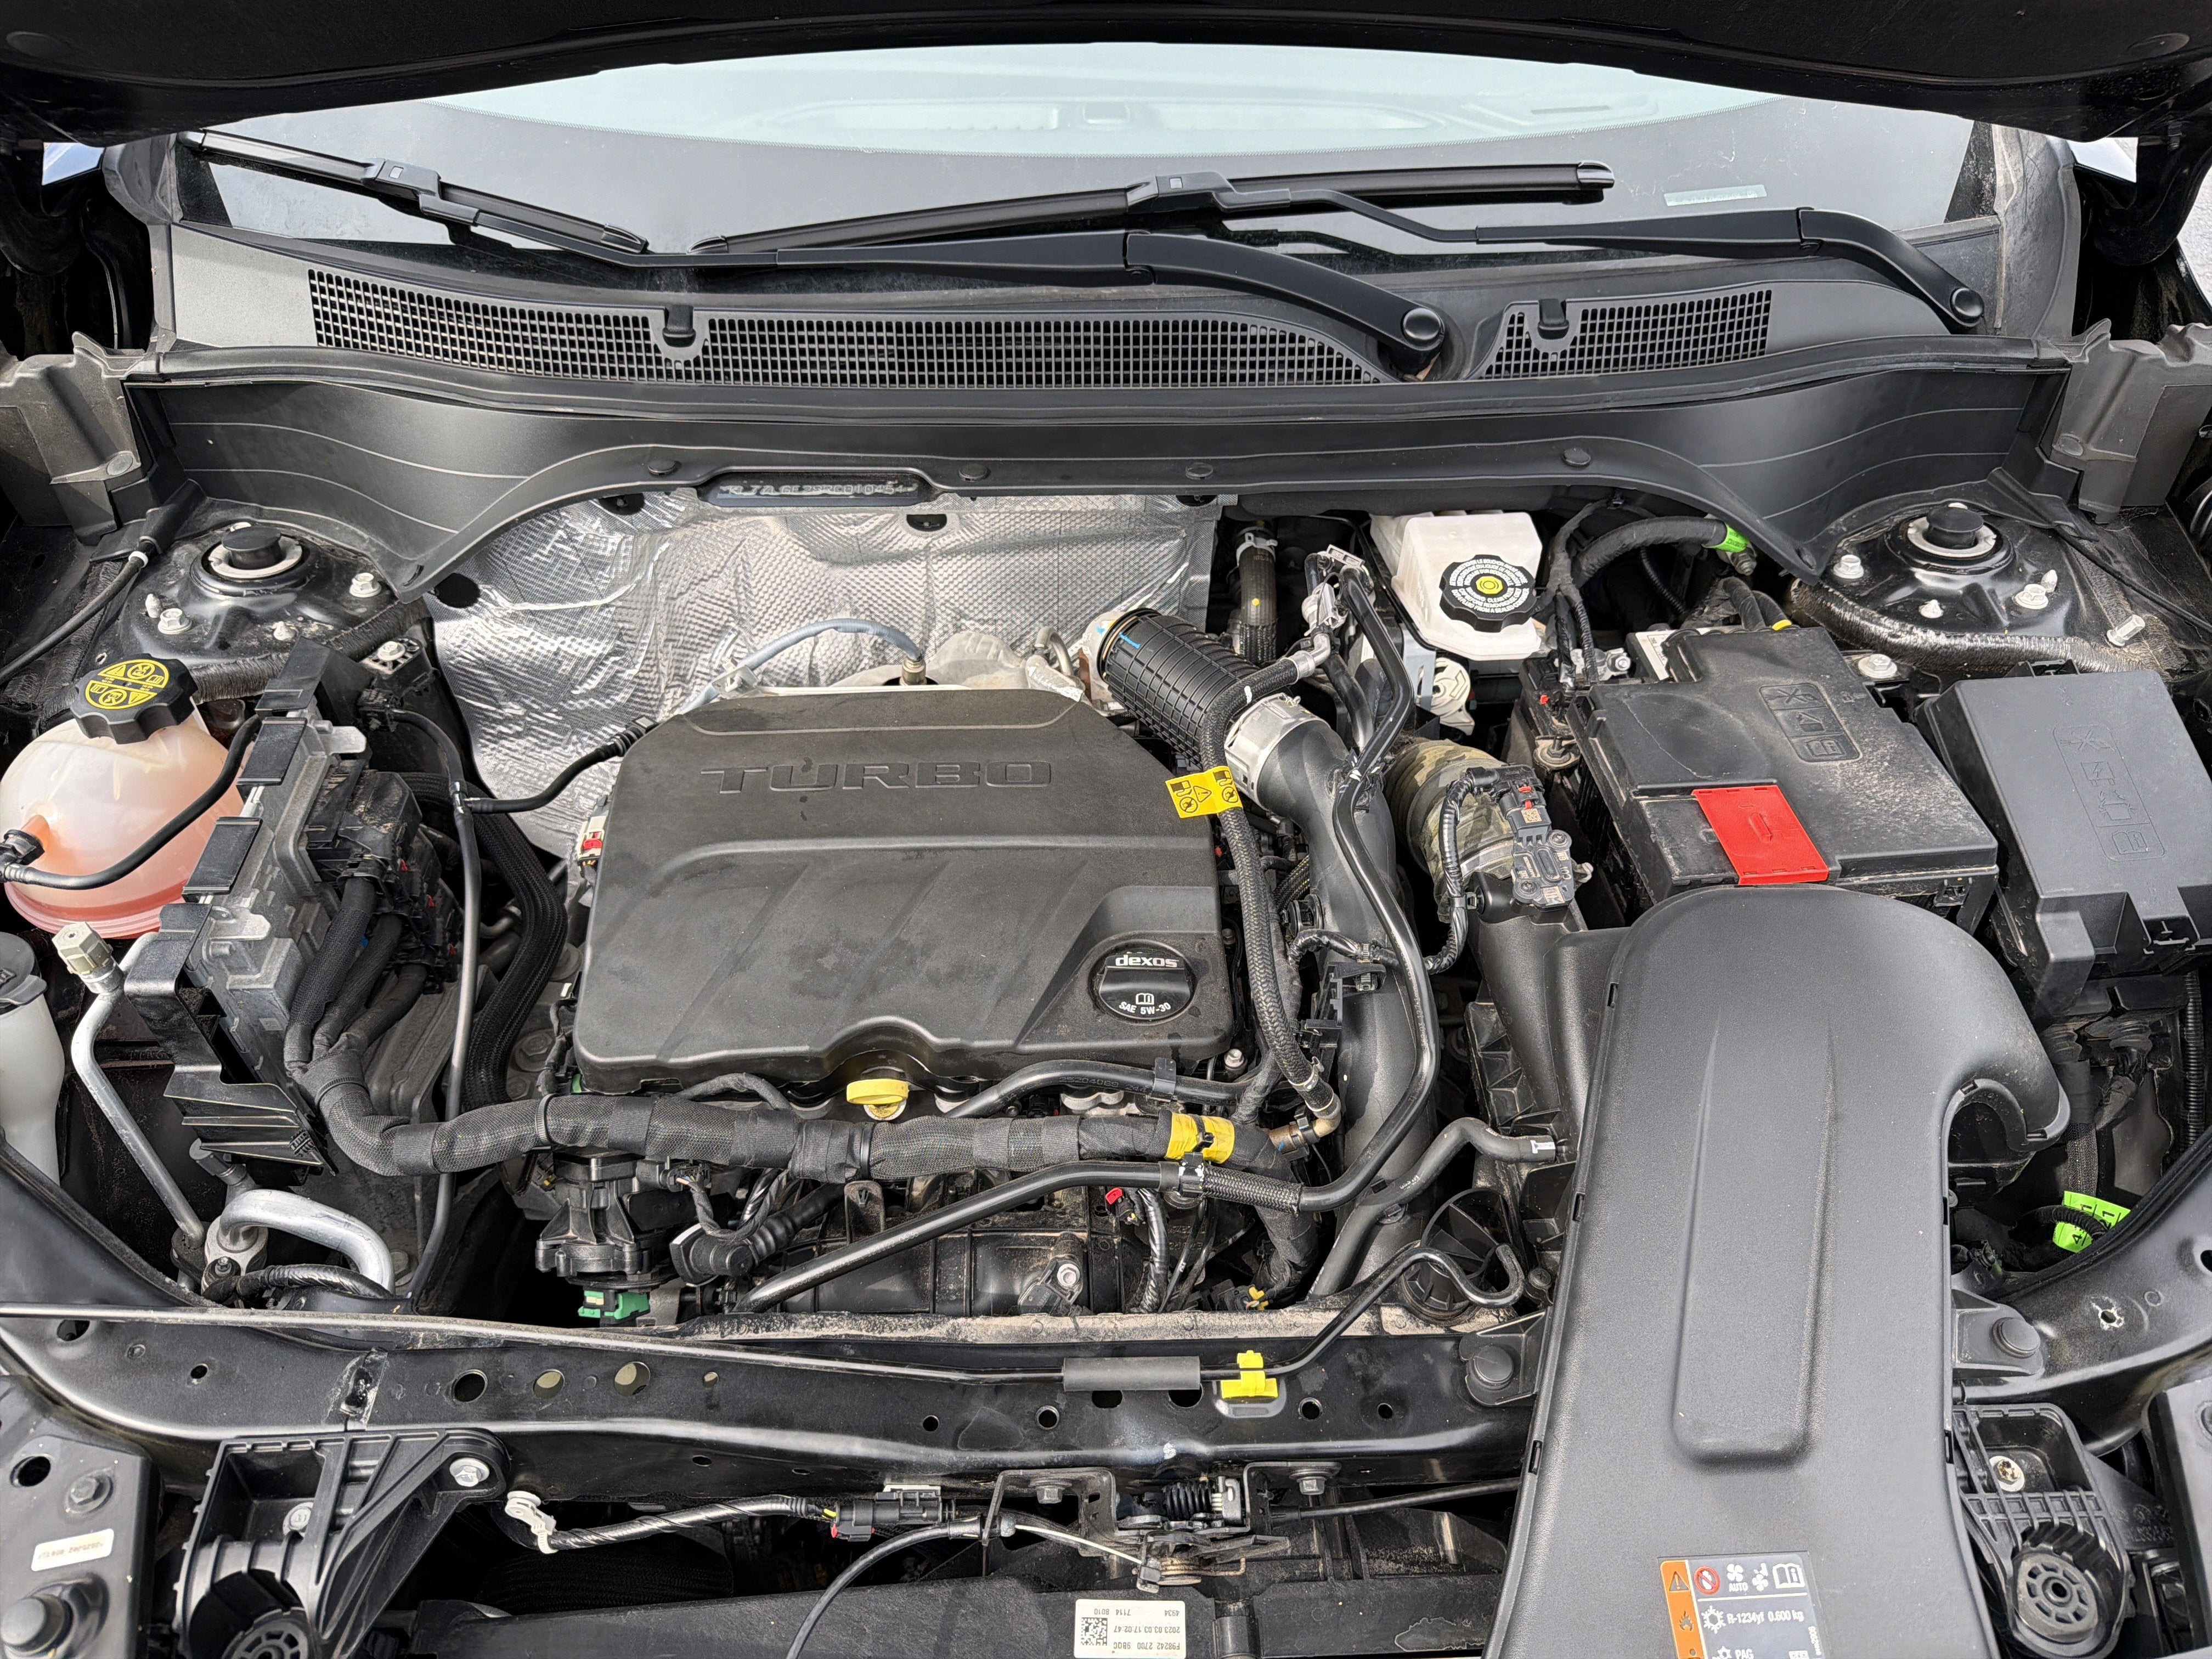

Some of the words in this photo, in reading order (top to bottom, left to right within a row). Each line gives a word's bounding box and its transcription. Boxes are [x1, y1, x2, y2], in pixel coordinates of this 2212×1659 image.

[701, 761, 1052, 793] TURBO
[1115, 955, 1180, 968] dexos
[1119, 1001, 1137, 1013] SAE
[1140, 1002, 1171, 1015] 5W-30
[1729, 1583, 1748, 1592] AUTO
[1726, 1611, 1765, 1624] R-1234yf
[1768, 1610, 1791, 1622] 0.600
[1791, 1610, 1804, 1622] kg
[1735, 1648, 1754, 1659] PAG
